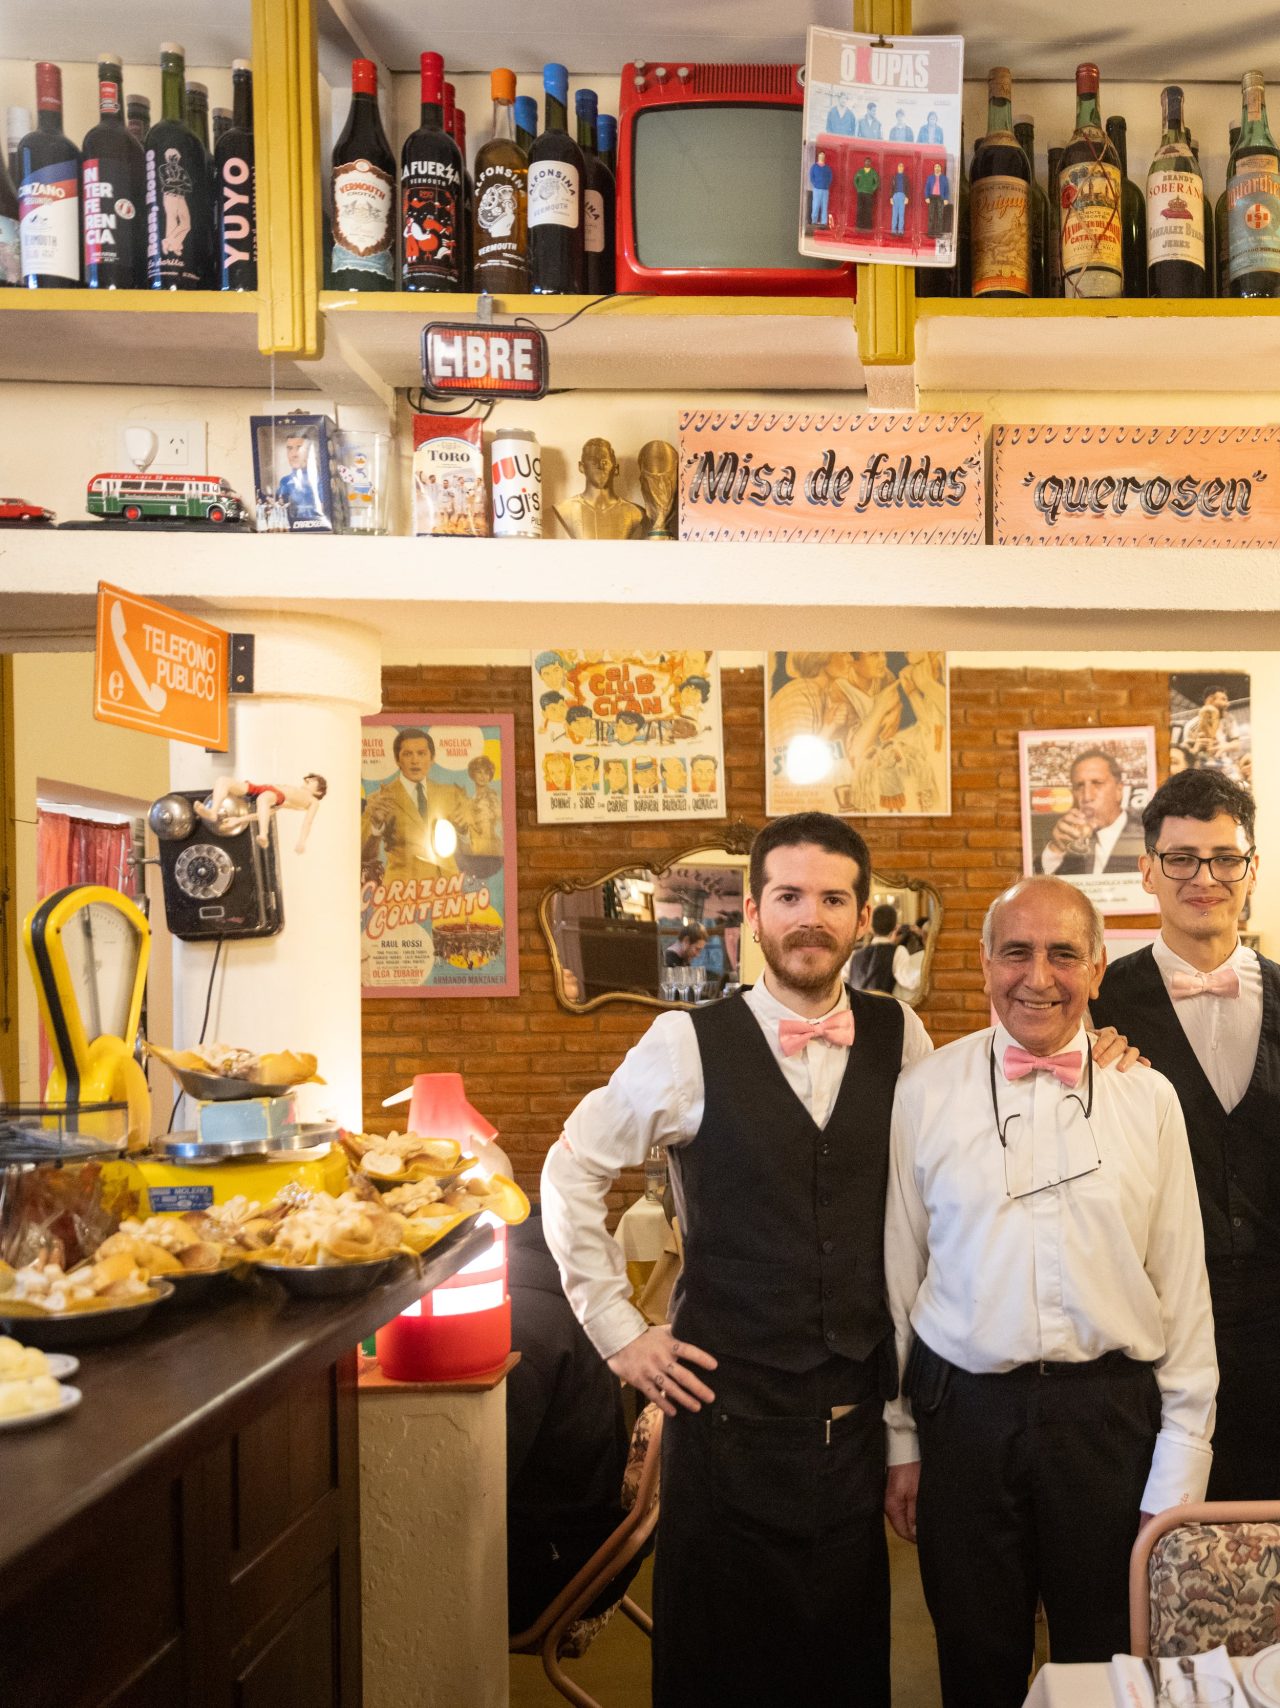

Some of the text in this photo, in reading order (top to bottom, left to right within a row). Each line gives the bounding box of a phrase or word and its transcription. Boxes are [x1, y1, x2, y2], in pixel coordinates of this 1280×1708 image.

[840, 47, 929, 88] OKUPAS
[83, 167, 98, 181] IN
[528, 168, 576, 196] ALFONSINA
[1162, 174, 1194, 183] BRANDY
[84, 182, 113, 198] TER
[339, 182, 386, 200] VERMOUTH
[1148, 182, 1203, 200] SOBERAN
[85, 199, 101, 213] FE
[222, 157, 250, 269] YUYO
[85, 214, 116, 229] REN
[86, 229, 115, 245] CIA
[478, 242, 518, 256] VERMOUTH
[432, 333, 534, 381] LIBRE
[427, 449, 471, 463] TORO
[803, 448, 854, 508] de
[493, 487, 541, 520] Ugi's
[141, 622, 217, 675] TELEFONO
[156, 657, 216, 702] PUBLICO
[439, 738, 472, 748] ANGELICA
[446, 748, 469, 758] MARIA
[360, 871, 465, 912] CORAZON
[366, 886, 491, 940] CONTENTO
[381, 939, 423, 948] RAUL ROSSI
[372, 969, 390, 979] OLGA
[433, 975, 466, 985] ARMANDO
[467, 975, 506, 985] MANZANER
